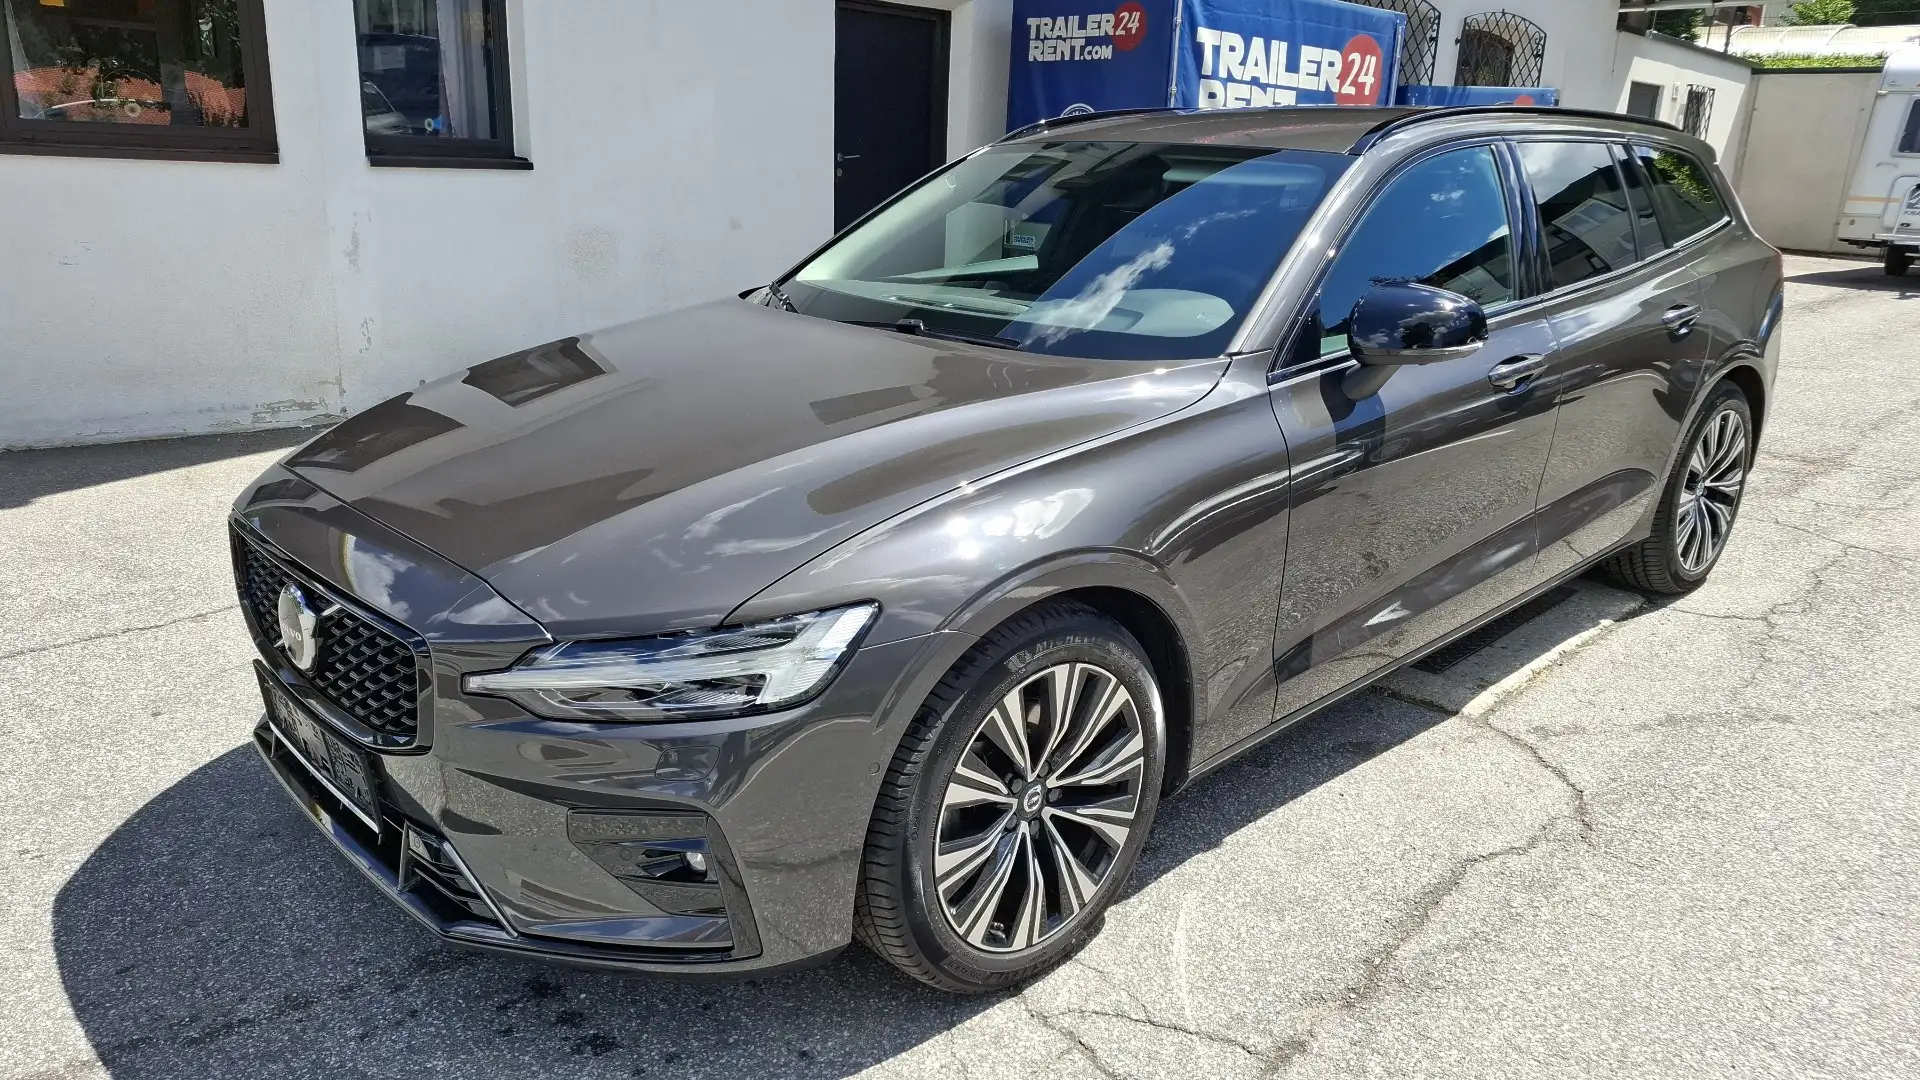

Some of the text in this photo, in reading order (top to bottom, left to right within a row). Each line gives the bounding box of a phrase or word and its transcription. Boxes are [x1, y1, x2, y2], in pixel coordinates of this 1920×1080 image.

[1026, 11, 1140, 39] TRAILER 24
[1196, 27, 1376, 96] TRAILER 24
